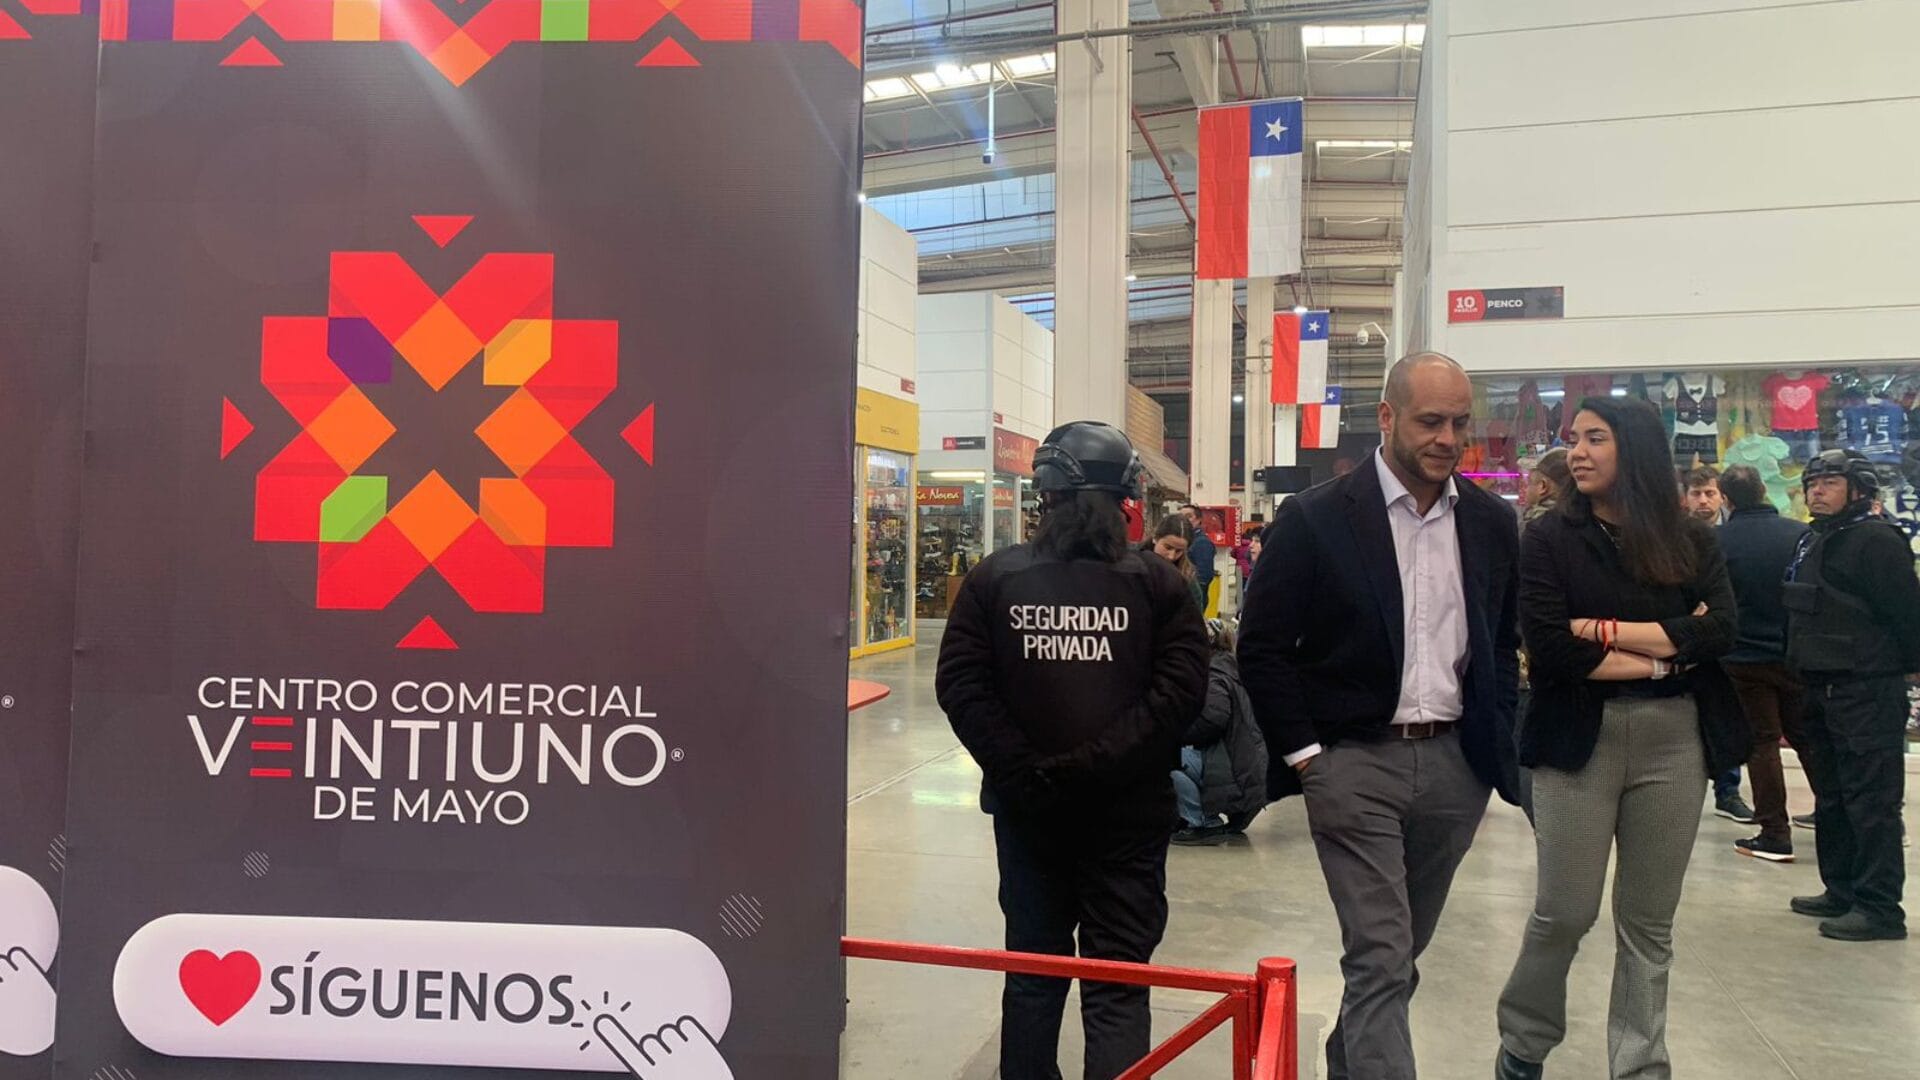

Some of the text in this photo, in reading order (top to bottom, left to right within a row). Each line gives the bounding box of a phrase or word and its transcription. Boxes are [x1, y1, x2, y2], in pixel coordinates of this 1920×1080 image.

[1455, 295, 1476, 309] 10
[1487, 299, 1524, 309] PENCO
[1009, 605, 1129, 631] SEGURIDAD
[1023, 634, 1113, 661] PRIVADA
[198, 676, 657, 718] CENTRO COMERCIAL
[187, 714, 667, 787] VEINTIUNO
[313, 785, 531, 825] DE MAYO
[269, 951, 575, 1025] SÍGUENOS
